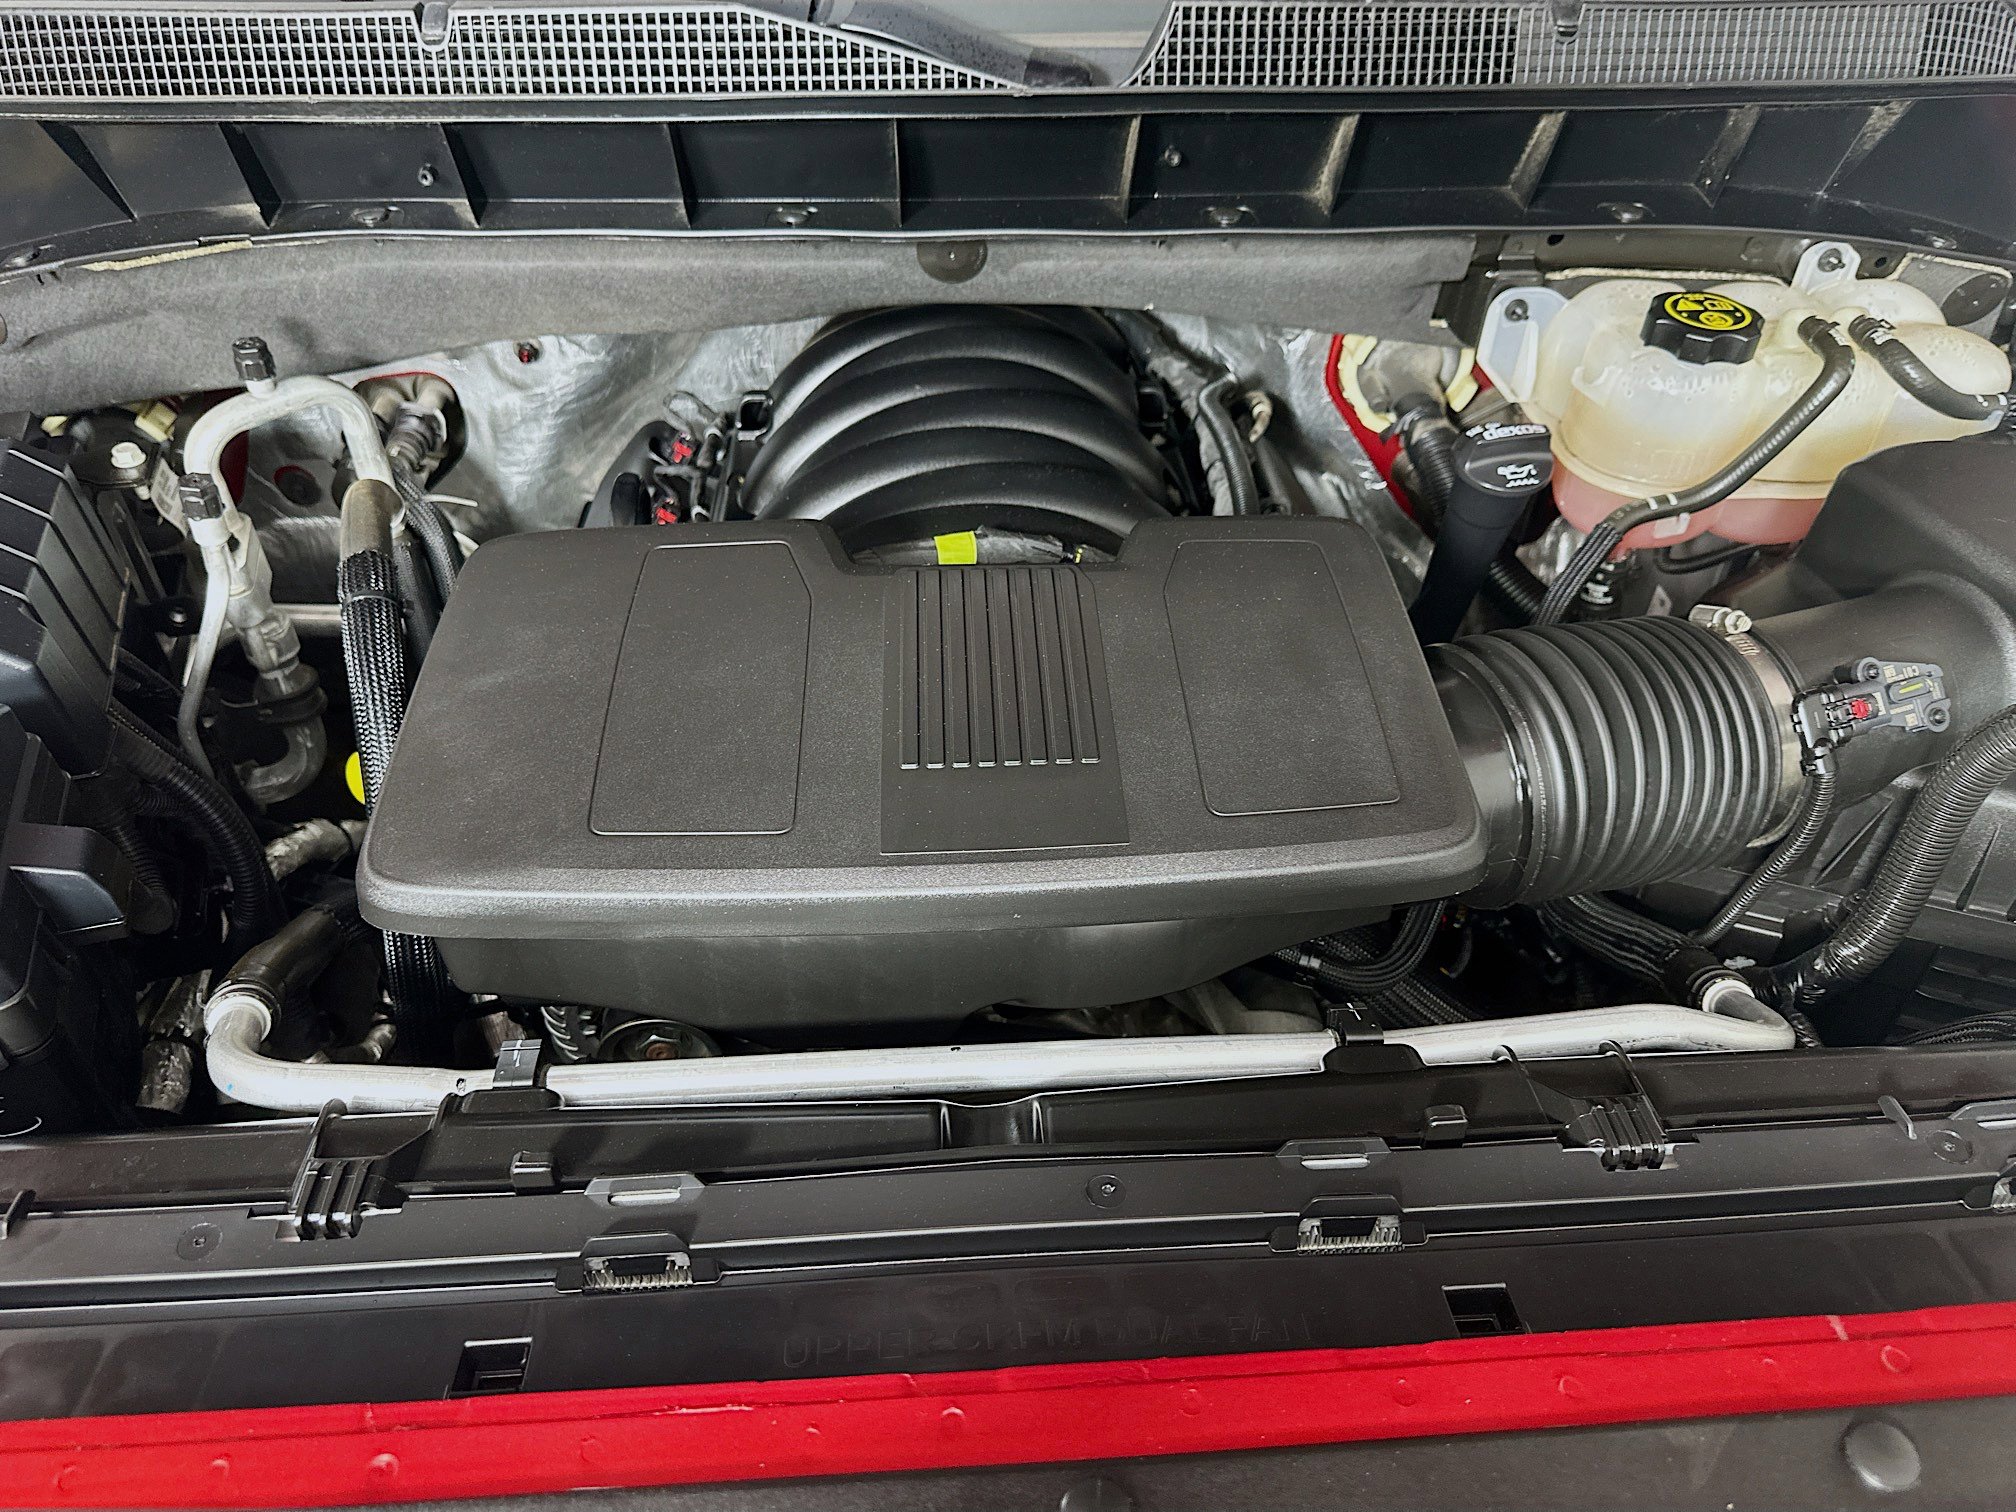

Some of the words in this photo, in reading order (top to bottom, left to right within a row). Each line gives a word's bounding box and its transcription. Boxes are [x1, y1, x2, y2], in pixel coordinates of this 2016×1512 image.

[1482, 424, 1547, 441] dexos
[783, 1328, 936, 1369] UPPER
[1228, 1312, 1311, 1342] FAN
